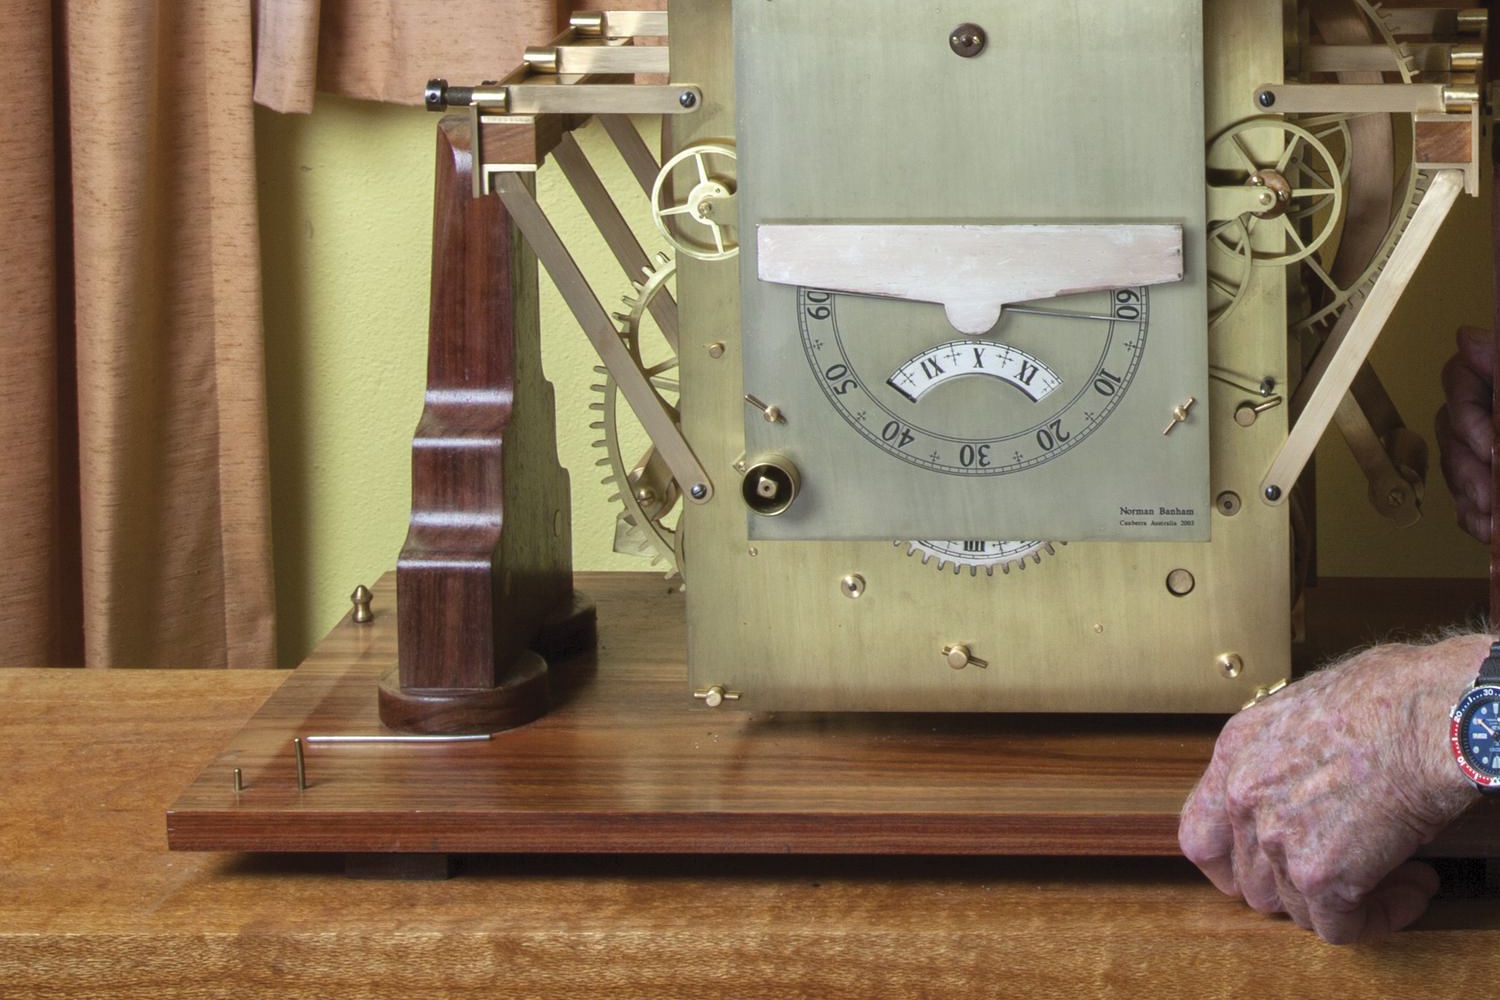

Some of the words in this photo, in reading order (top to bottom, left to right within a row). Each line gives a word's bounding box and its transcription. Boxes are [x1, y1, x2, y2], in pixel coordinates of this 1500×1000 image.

[973, 348, 985, 368] X
[825, 364, 858, 395] 50
[881, 420, 915, 448] 40
[959, 444, 991, 467] 30
[1036, 419, 1070, 451] 20
[1093, 368, 1121, 396] 10
[1116, 289, 1140, 320] 60
[1119, 506, 1155, 516] Norman
[1159, 506, 1195, 516] Banham
[1483, 688, 1494, 696] 30
